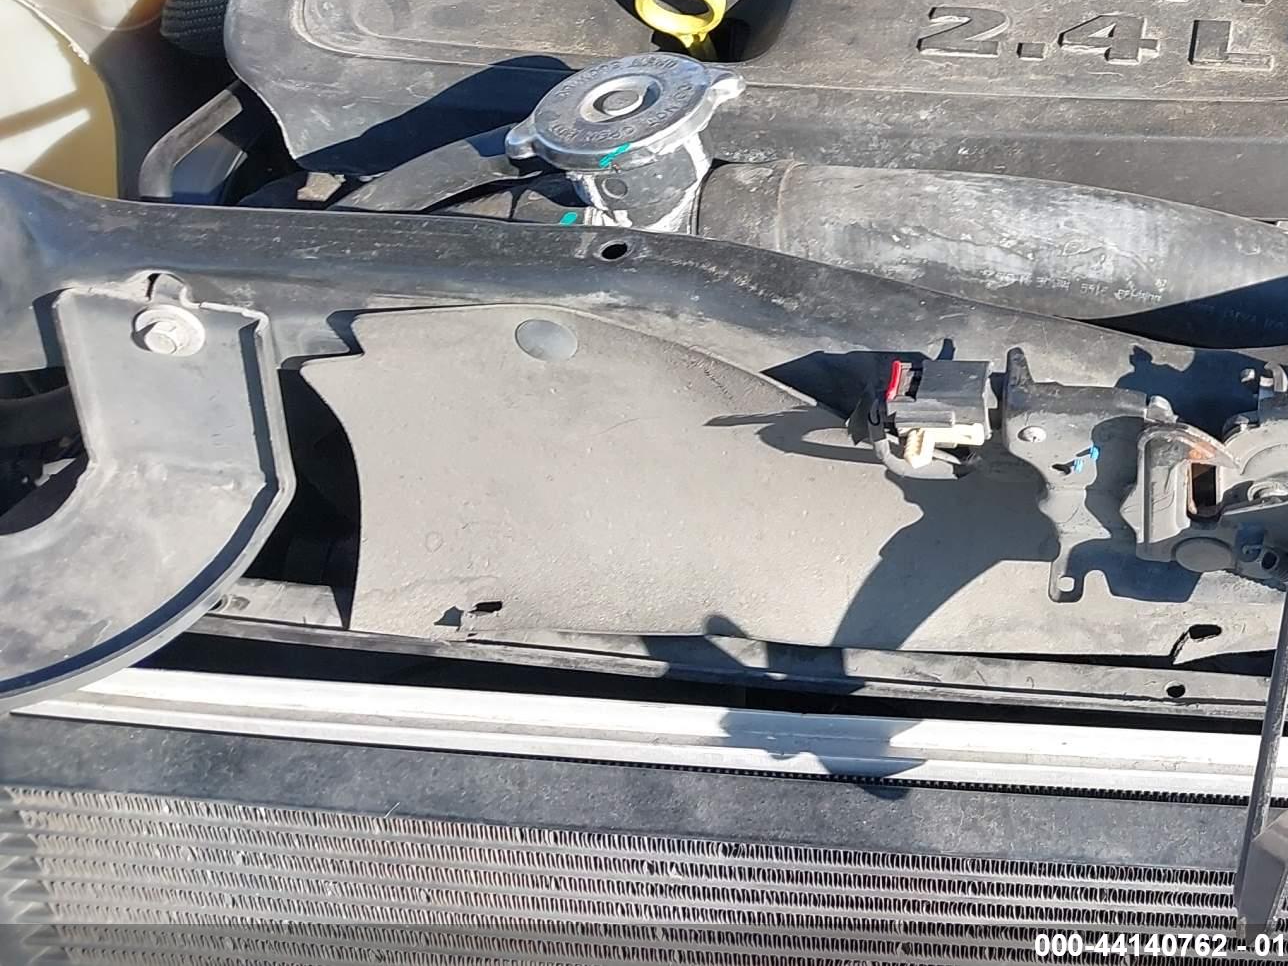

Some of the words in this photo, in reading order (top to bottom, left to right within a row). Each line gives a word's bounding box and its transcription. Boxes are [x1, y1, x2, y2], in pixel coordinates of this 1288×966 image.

[917, 7, 1161, 65] 2.4
[1189, 20, 1275, 71] L
[647, 105, 674, 128] NOT
[586, 126, 636, 142] OPEN
